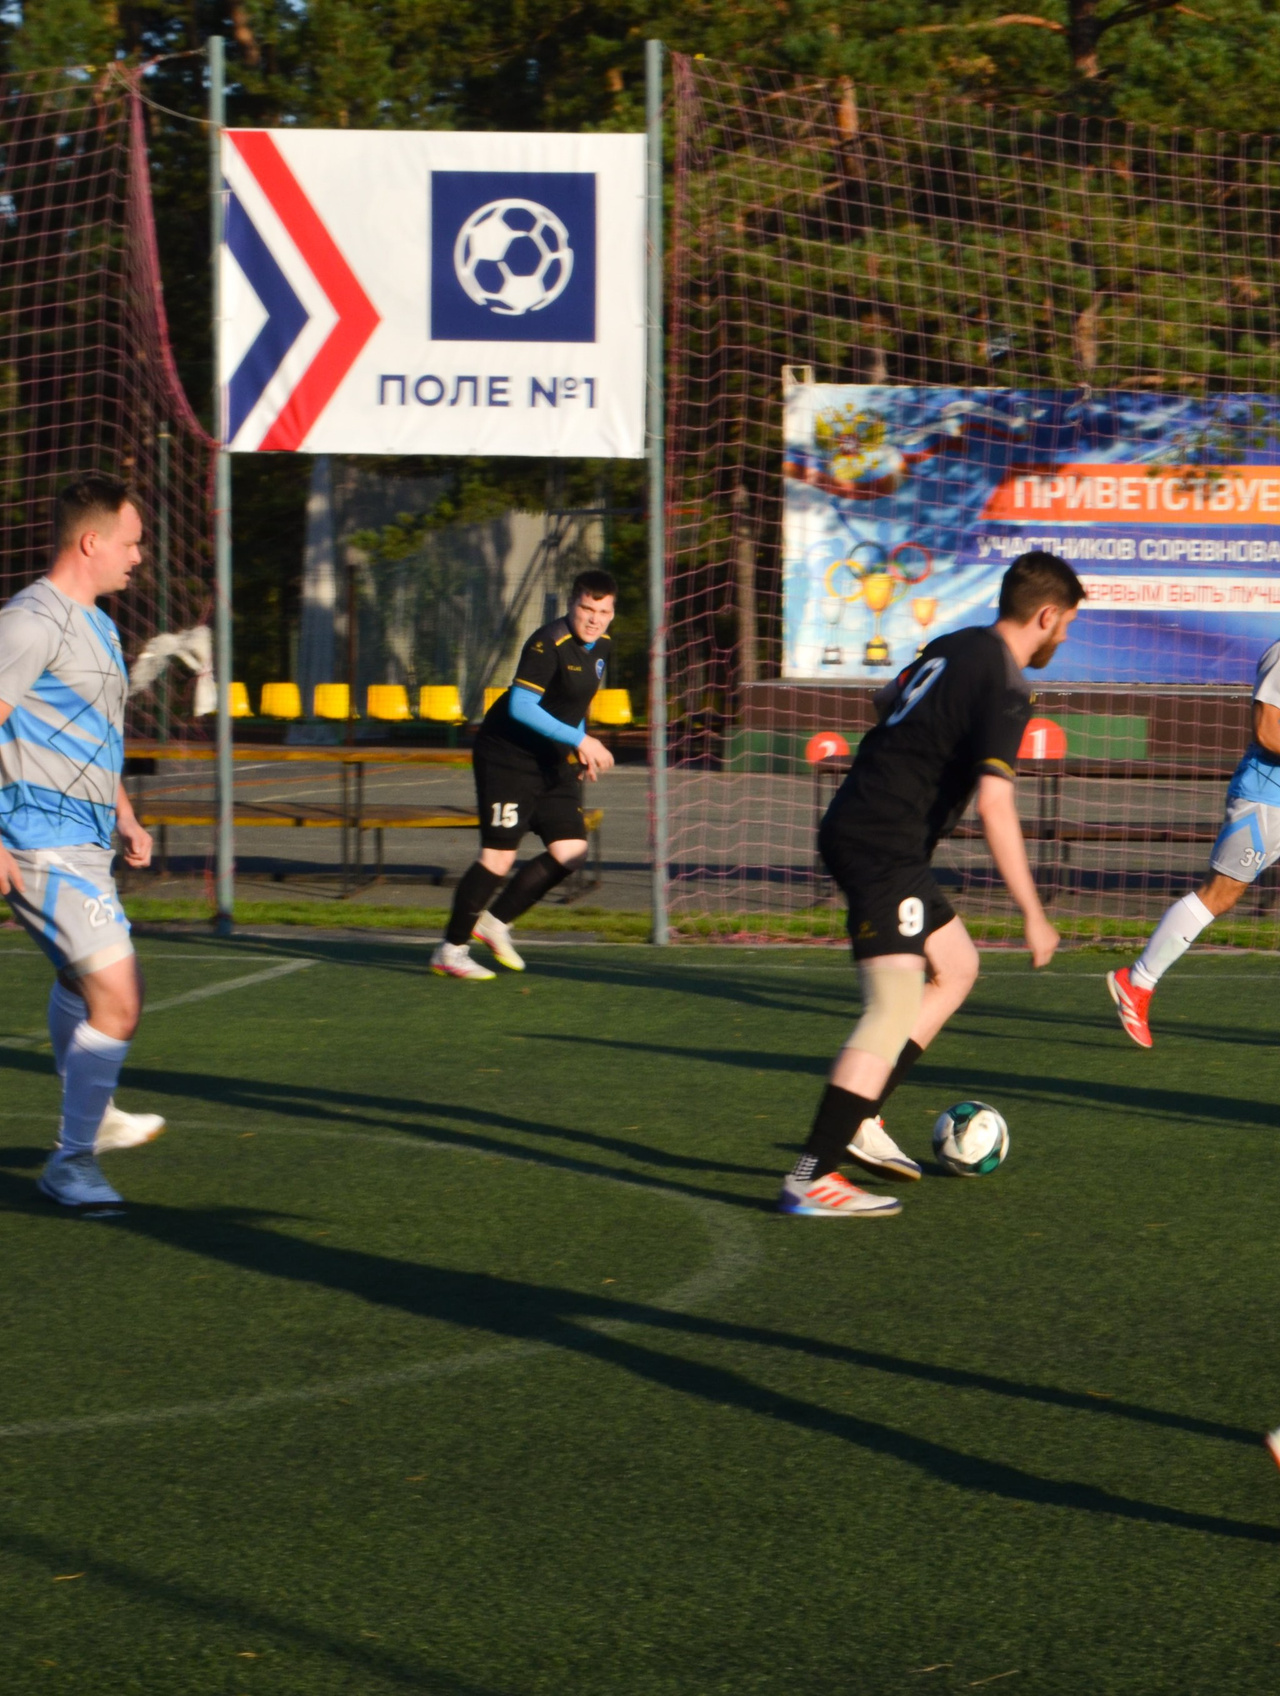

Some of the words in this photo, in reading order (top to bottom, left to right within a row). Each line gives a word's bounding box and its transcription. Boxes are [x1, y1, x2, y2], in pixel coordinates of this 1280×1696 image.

[379, 374, 511, 406] ПОЛЕ
[529, 376, 597, 408] №1
[1085, 583, 1166, 603] ЕРВЫМ
[1168, 584, 1223, 603] БЫТЬ
[885, 657, 947, 727] 9
[1028, 728, 1048, 759] 1
[491, 802, 519, 828] 15
[1239, 847, 1266, 871] 34
[83, 892, 116, 928] 25
[898, 896, 924, 937] 9
